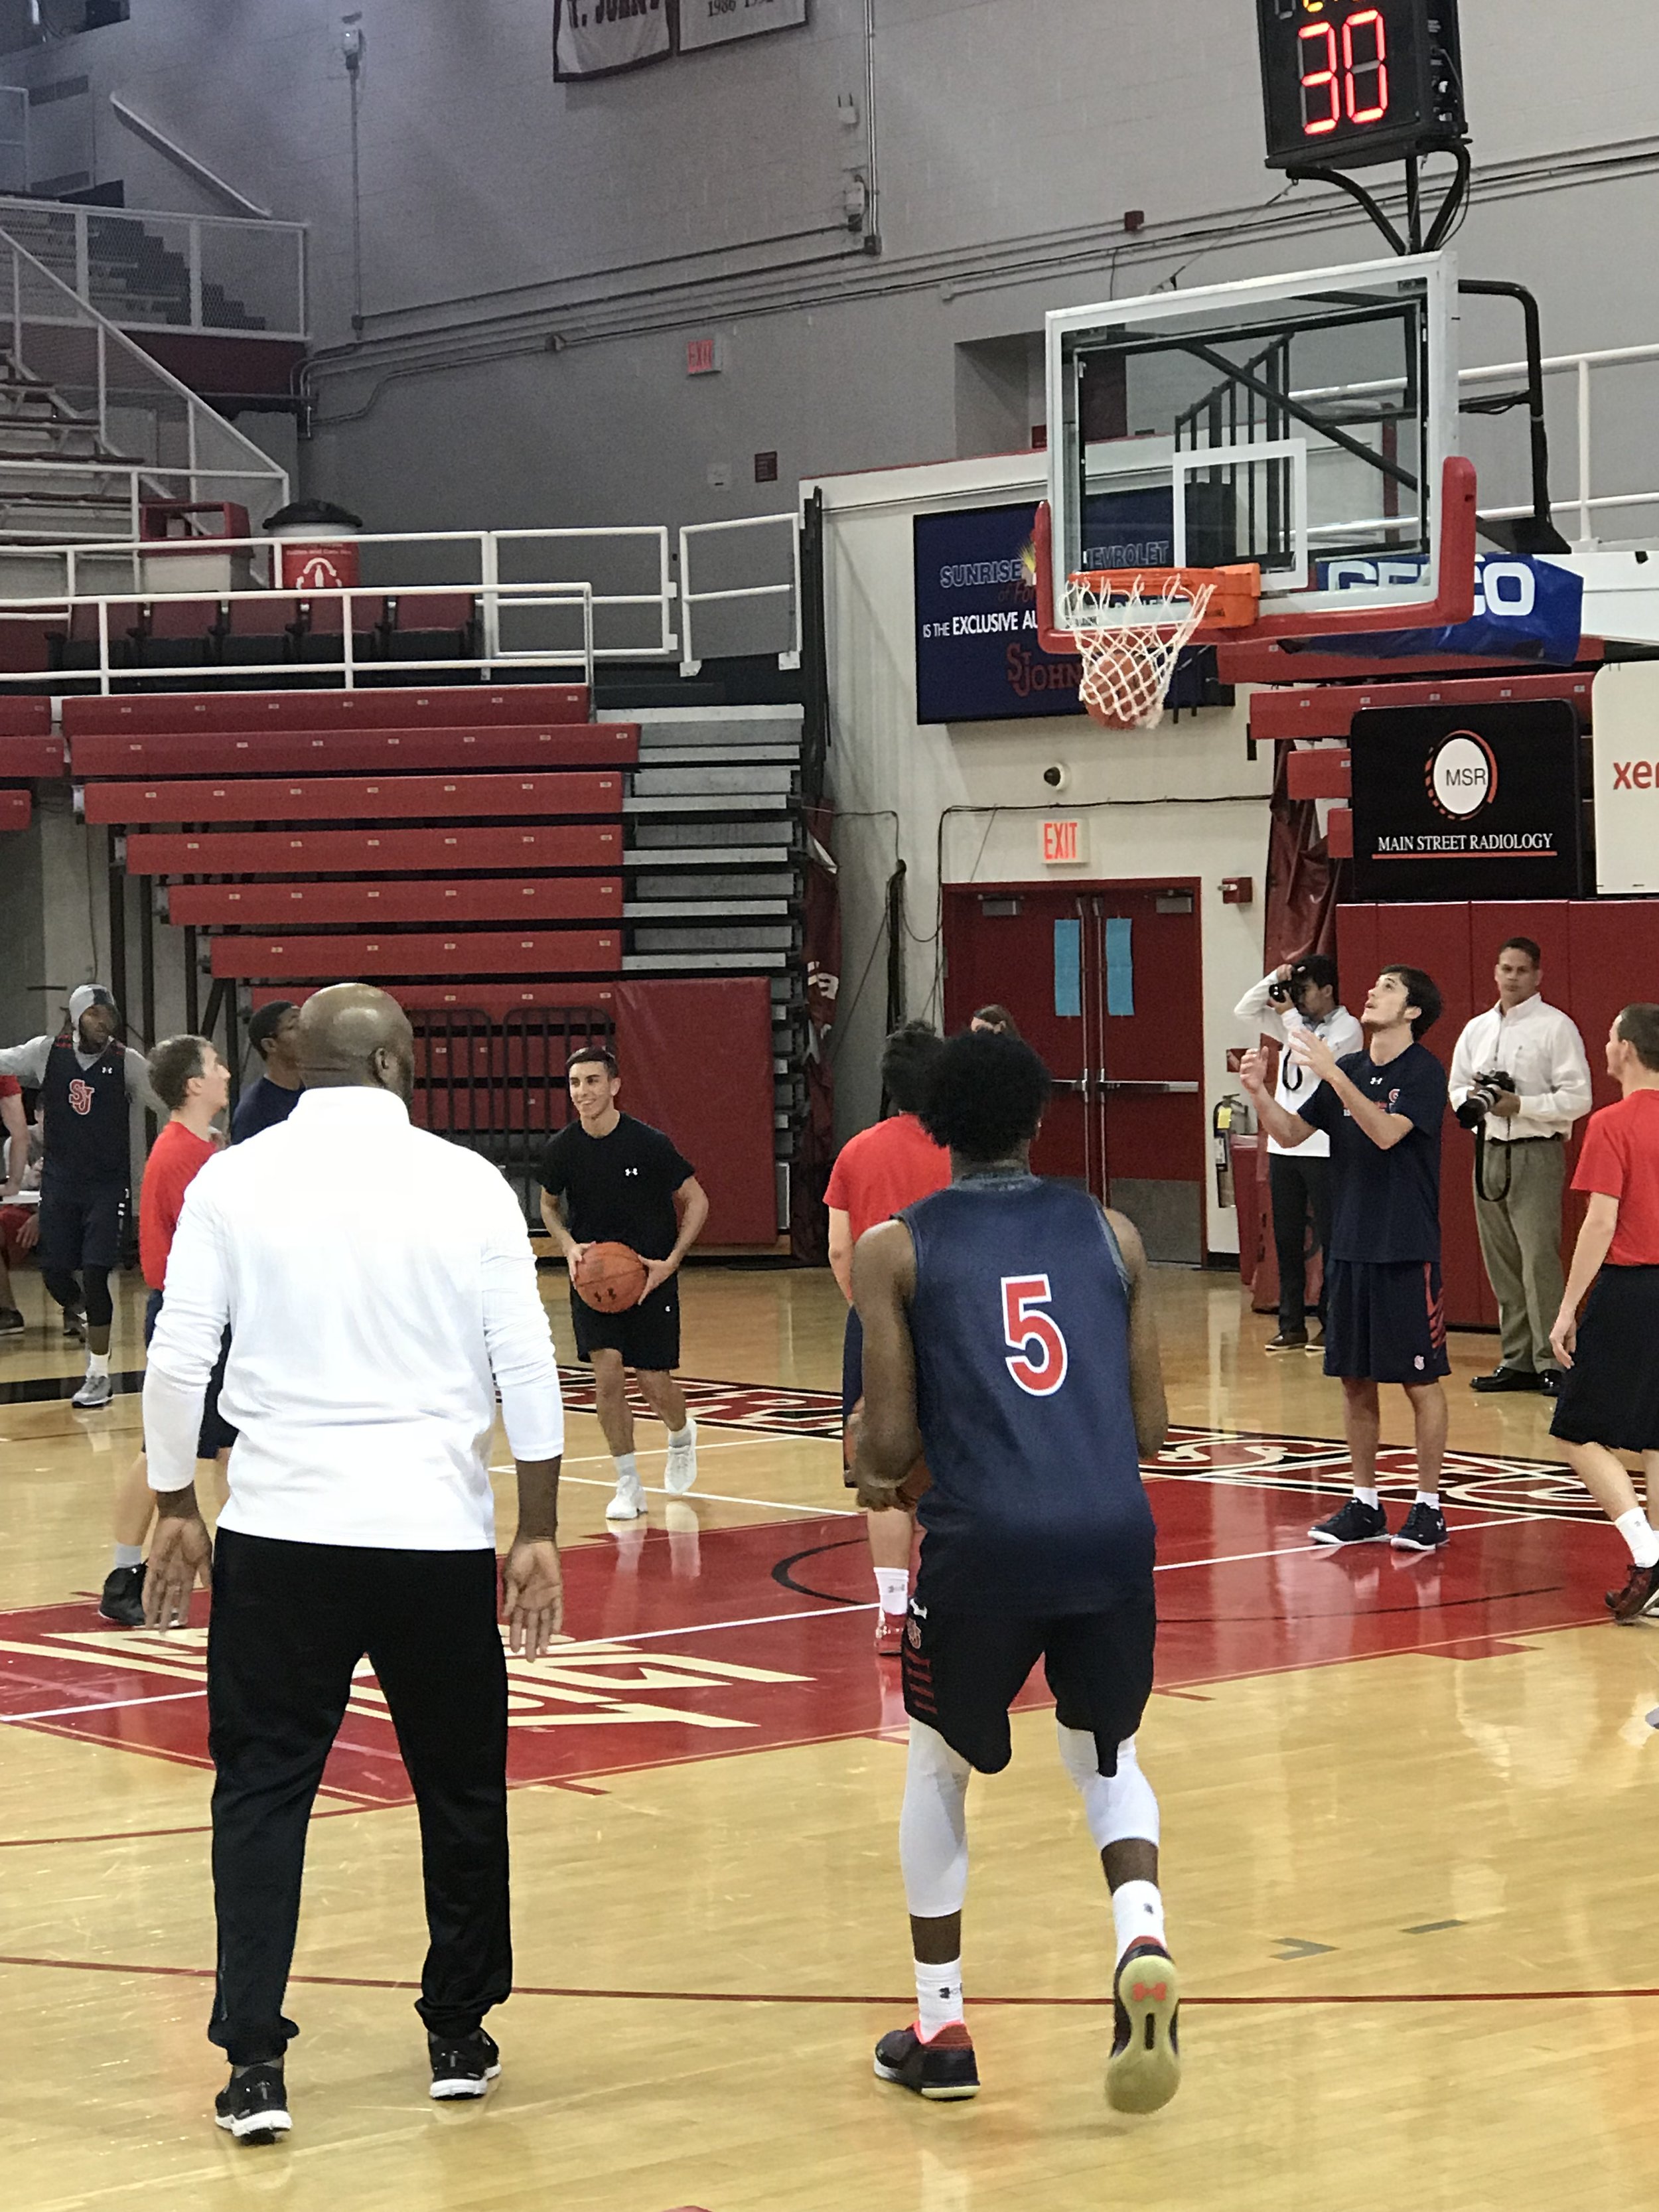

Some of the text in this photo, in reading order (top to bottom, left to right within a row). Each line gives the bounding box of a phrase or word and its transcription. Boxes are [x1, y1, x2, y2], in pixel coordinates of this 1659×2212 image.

[1298, 9, 1388, 135] 30
[940, 559, 1023, 589] SUNRISE
[922, 624, 932, 638] IS
[933, 623, 950, 637] THE
[952, 611, 1019, 635] EXCLUSIVE
[1446, 768, 1486, 786] MSR
[1044, 822, 1078, 860] EXIT
[1378, 833, 1553, 851] MAIN STREET RADIOLOGY
[1001, 1274, 1068, 1396] 5
